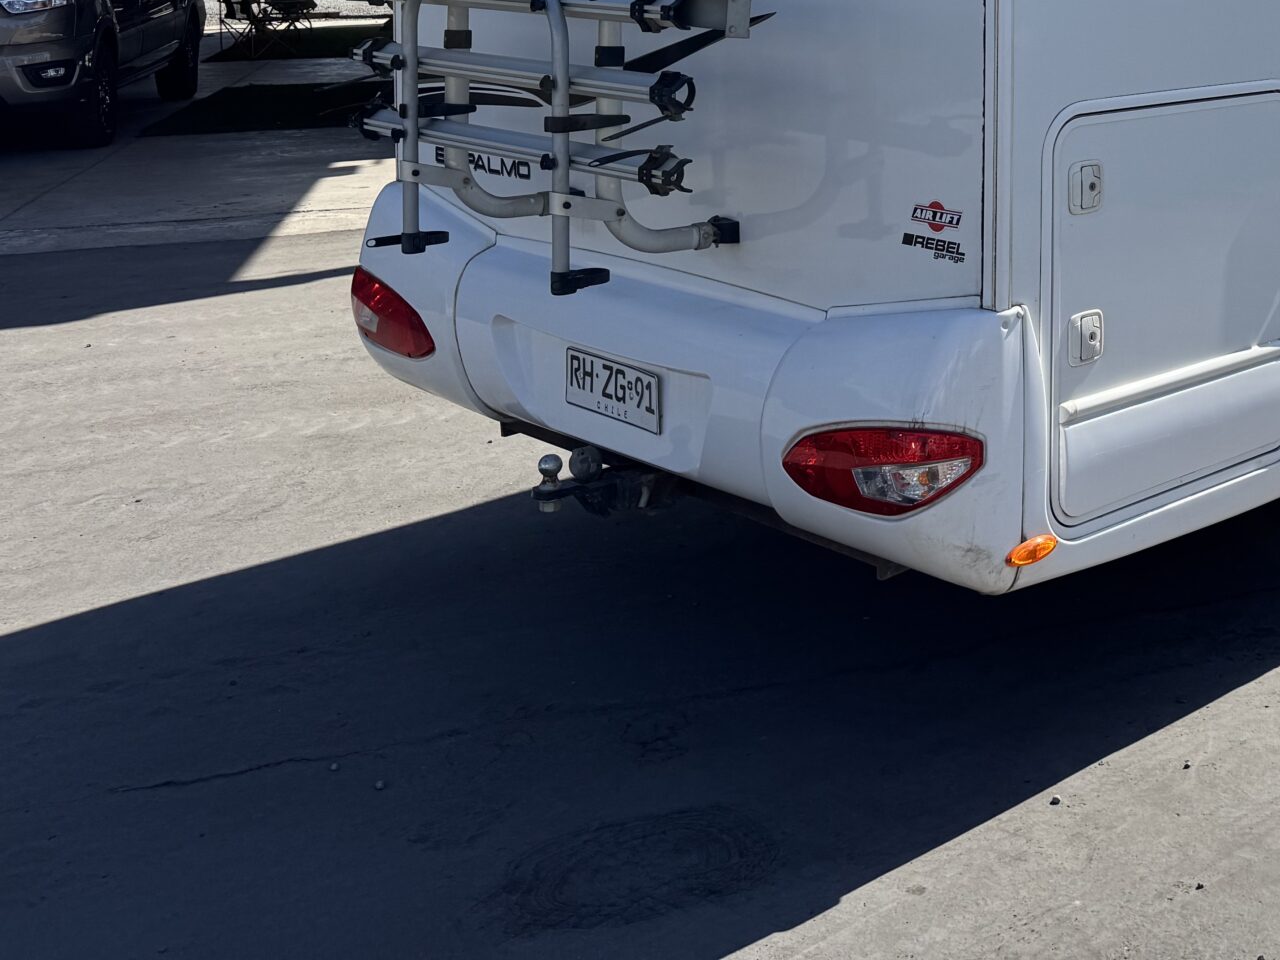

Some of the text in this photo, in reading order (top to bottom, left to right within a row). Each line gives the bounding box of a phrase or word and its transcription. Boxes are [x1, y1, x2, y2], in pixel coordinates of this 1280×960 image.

[913, 208, 960, 225] AIR LIFT
[913, 235, 966, 257] REBEL
[933, 251, 965, 263] garage
[596, 400, 628, 419] CHILE
